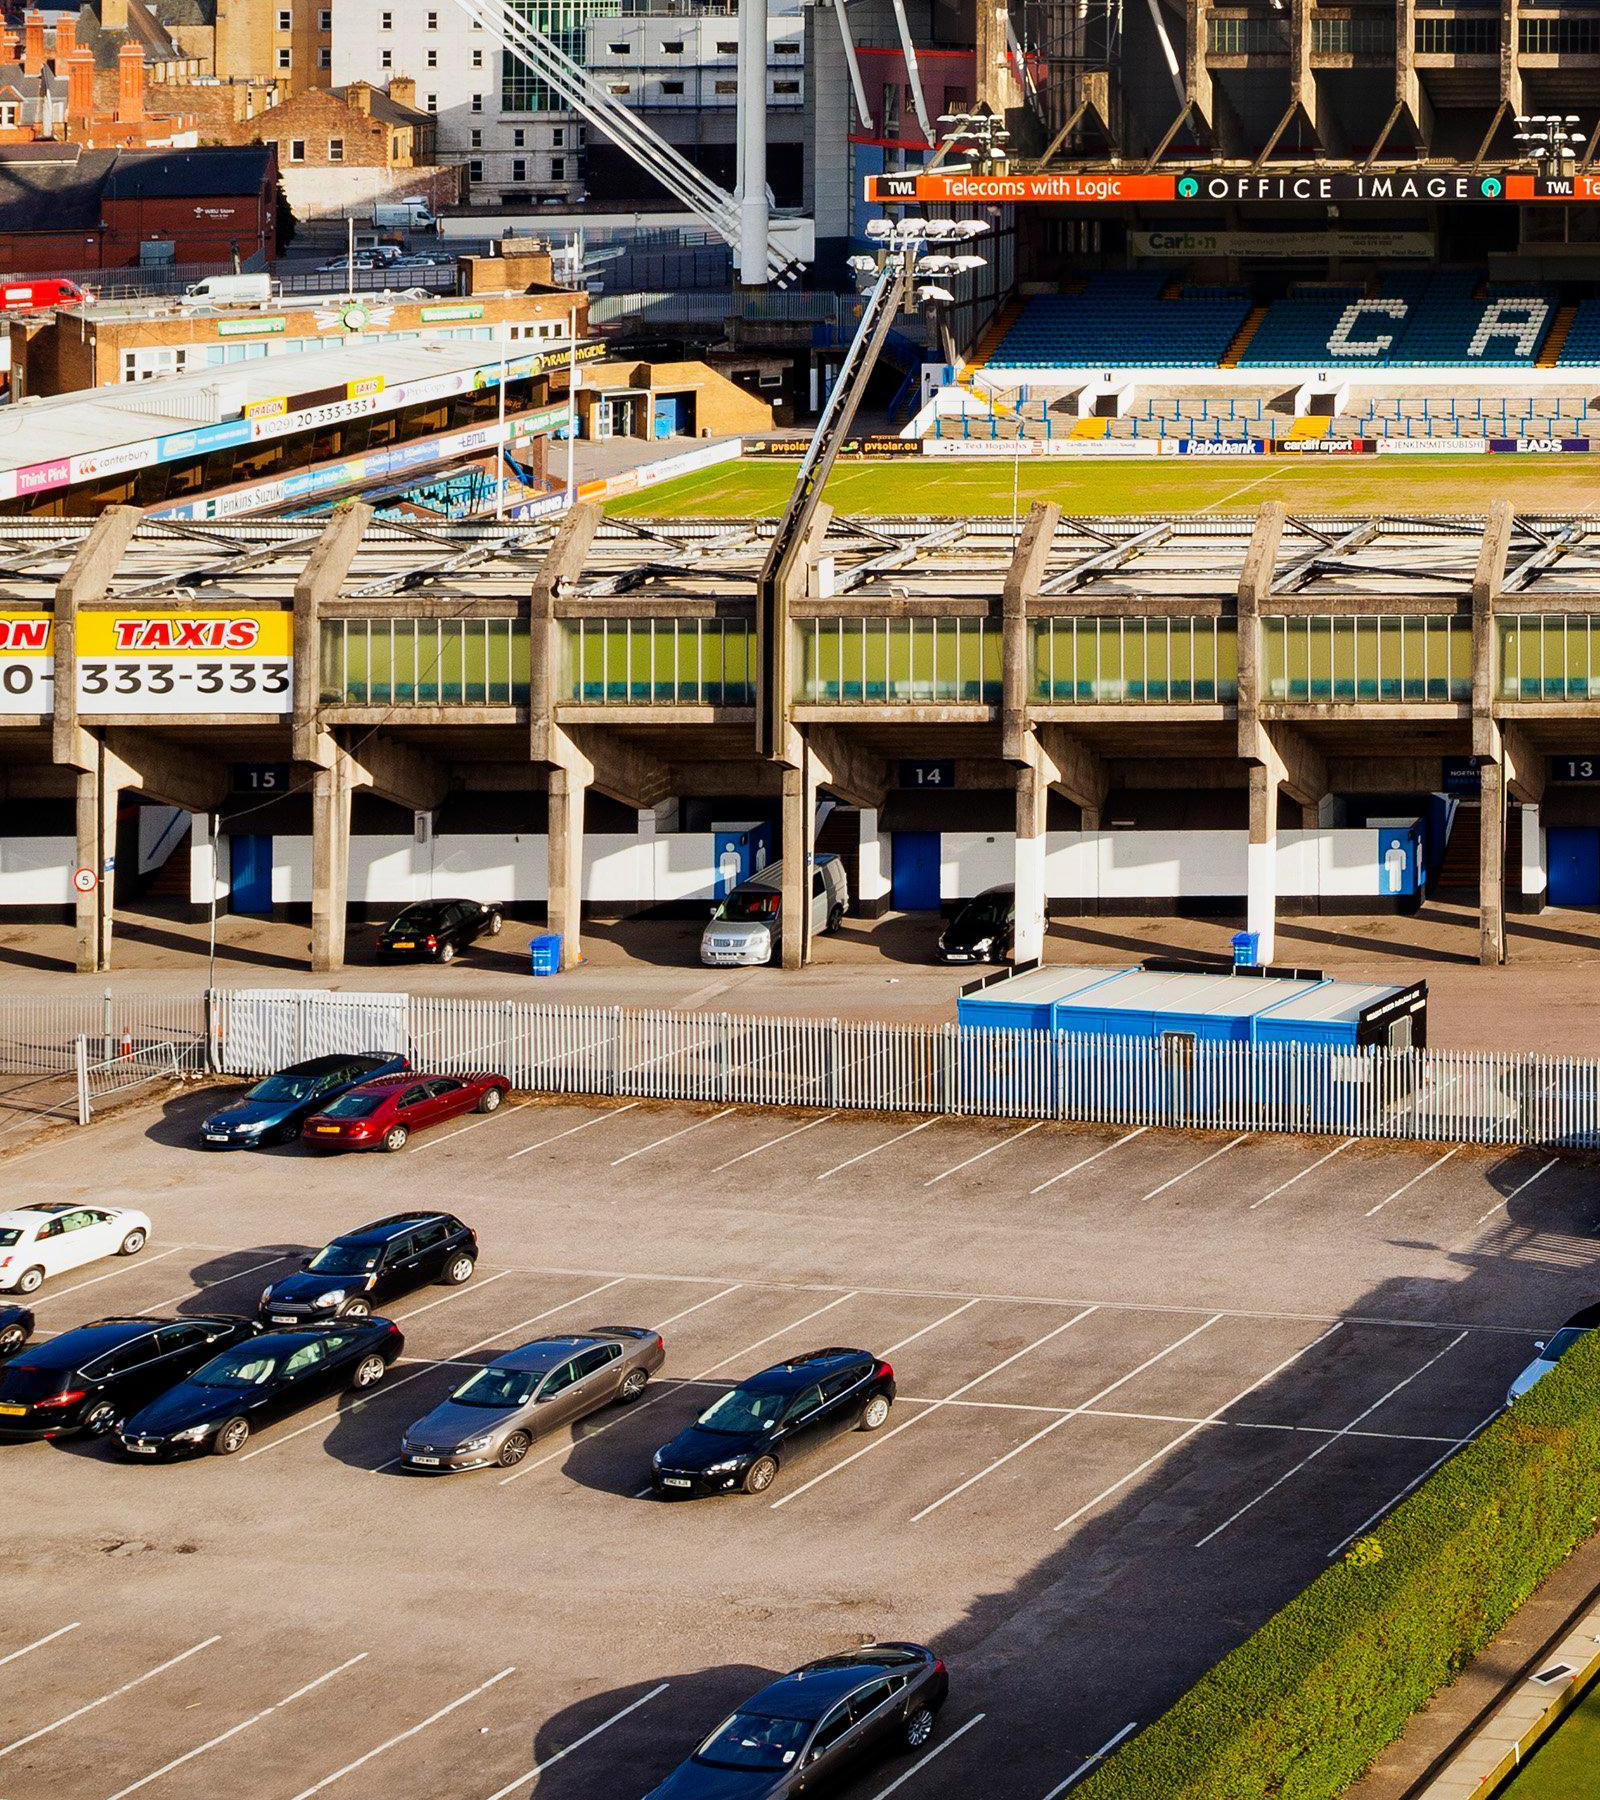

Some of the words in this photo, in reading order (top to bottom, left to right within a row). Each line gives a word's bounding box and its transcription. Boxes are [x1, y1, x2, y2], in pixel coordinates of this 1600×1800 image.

[888, 181, 915, 195] TWL
[943, 178, 1025, 196] Telecoms
[1031, 178, 1070, 196] with
[1076, 179, 1121, 200] Logic
[1208, 178, 1332, 198] OFFICE
[1358, 178, 1468, 198] IMAGE
[1547, 181, 1573, 194] TWL
[542, 353, 570, 368] PYRAM
[575, 344, 606, 361] HYGIENE
[355, 381, 378, 395] TAXIS
[249, 401, 284, 418] DRAGON
[296, 399, 368, 427] 20-333-333
[771, 441, 812, 454] pvsolar
[864, 441, 918, 454] pvsolar.eu
[1186, 439, 1256, 455] Rabobank
[1516, 439, 1563, 452] EADS
[100, 449, 149, 469] canterbury
[19, 469, 46, 488] Think
[47, 462, 69, 482] Pink
[219, 489, 252, 515] Jenkins
[256, 482, 286, 505] Suzuki
[114, 619, 259, 649] TAXIS
[81, 663, 290, 694] 333-333
[916, 769, 941, 784] 14
[1568, 762, 1593, 777] 13
[250, 772, 275, 788] 15
[82, 875, 90, 886] 5
